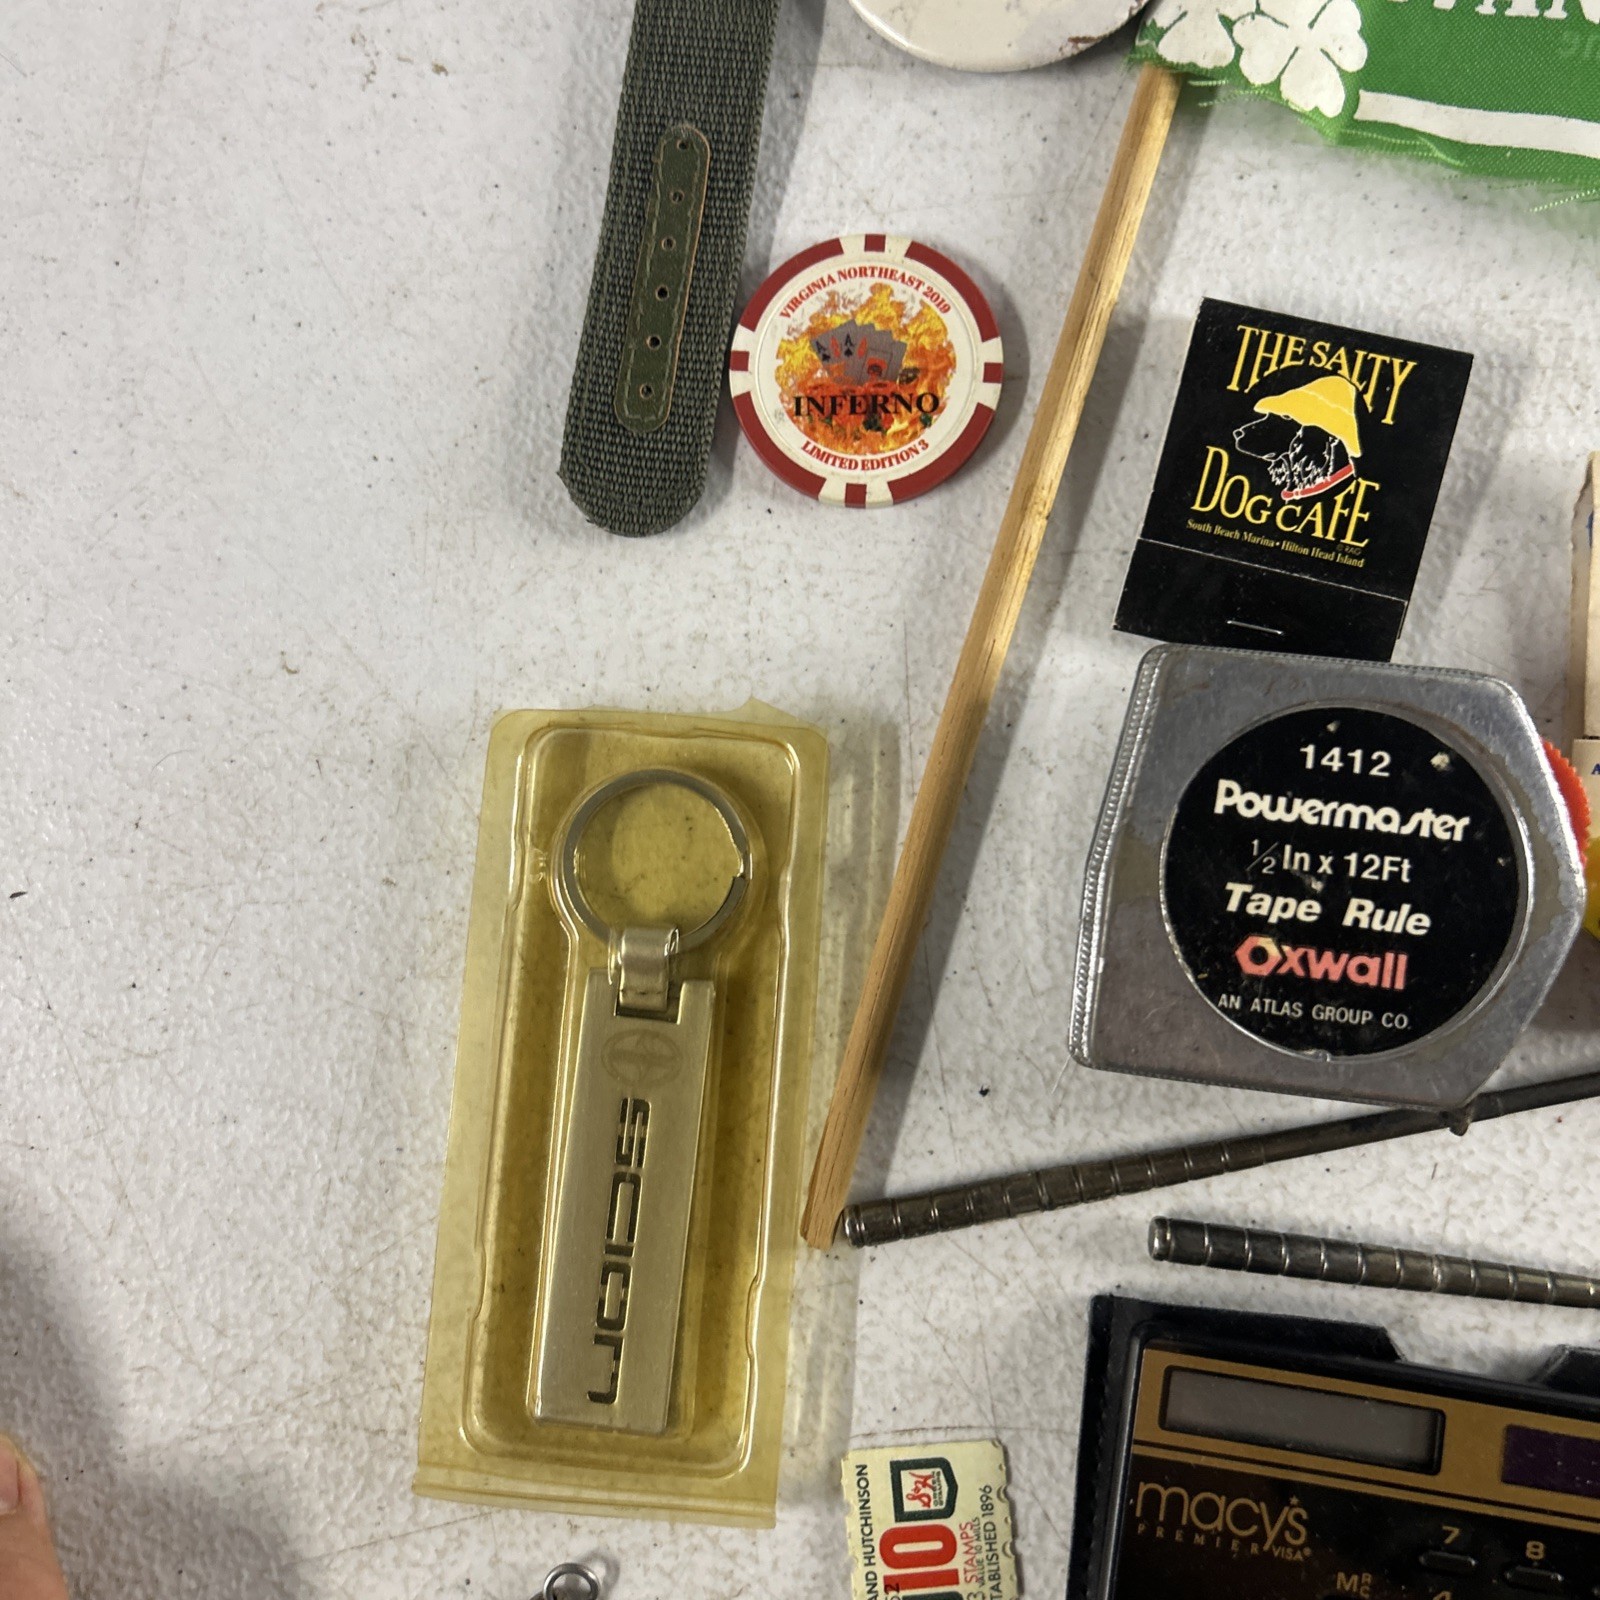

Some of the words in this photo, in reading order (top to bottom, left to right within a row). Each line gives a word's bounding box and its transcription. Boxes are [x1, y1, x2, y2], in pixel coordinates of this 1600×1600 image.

[779, 276, 837, 320] VIRGINIA
[837, 266, 925, 291] NORTHEAST
[922, 285, 952, 314] 2019
[1226, 325, 1307, 393] THE
[1309, 341, 1417, 425] SALTY
[793, 391, 940, 417] INFERNO
[800, 440, 859, 470] LIMITED
[861, 449, 917, 471] EDITION
[917, 440, 929, 452] 3
[1191, 445, 1273, 524] DOG
[1275, 477, 1380, 547] CAFE
[1186, 519, 1212, 533] South
[1213, 525, 1241, 540] Beach
[1281, 540, 1310, 555] Hilton
[1311, 547, 1335, 561] Head
[1335, 553, 1365, 568] Island
[1300, 744, 1392, 777] 1412
[1213, 778, 1470, 842] Powermaster
[1282, 844, 1311, 872] In
[1316, 856, 1334, 875] x
[1343, 852, 1412, 883] 12Ft
[1224, 881, 1323, 924] Tape
[1341, 898, 1431, 936] Rule
[1234, 935, 1408, 990] Oxwall
[1217, 993, 1241, 1010] AN
[1250, 998, 1303, 1018] ATLAS
[1312, 1004, 1373, 1025] GROUP
[855, 1464, 876, 1567] HUTCHINSON
[979, 1485, 994, 1517] 1896
[972, 1517, 981, 1542] MILLS
[1137, 1522, 1260, 1555] PREMIER
[1442, 1526, 1461, 1544] 7
[879, 1524, 960, 1591] 10
[959, 1522, 979, 1584] STAMPS
[1525, 1540, 1545, 1560] 8
[975, 1557, 986, 1588] VALUE
